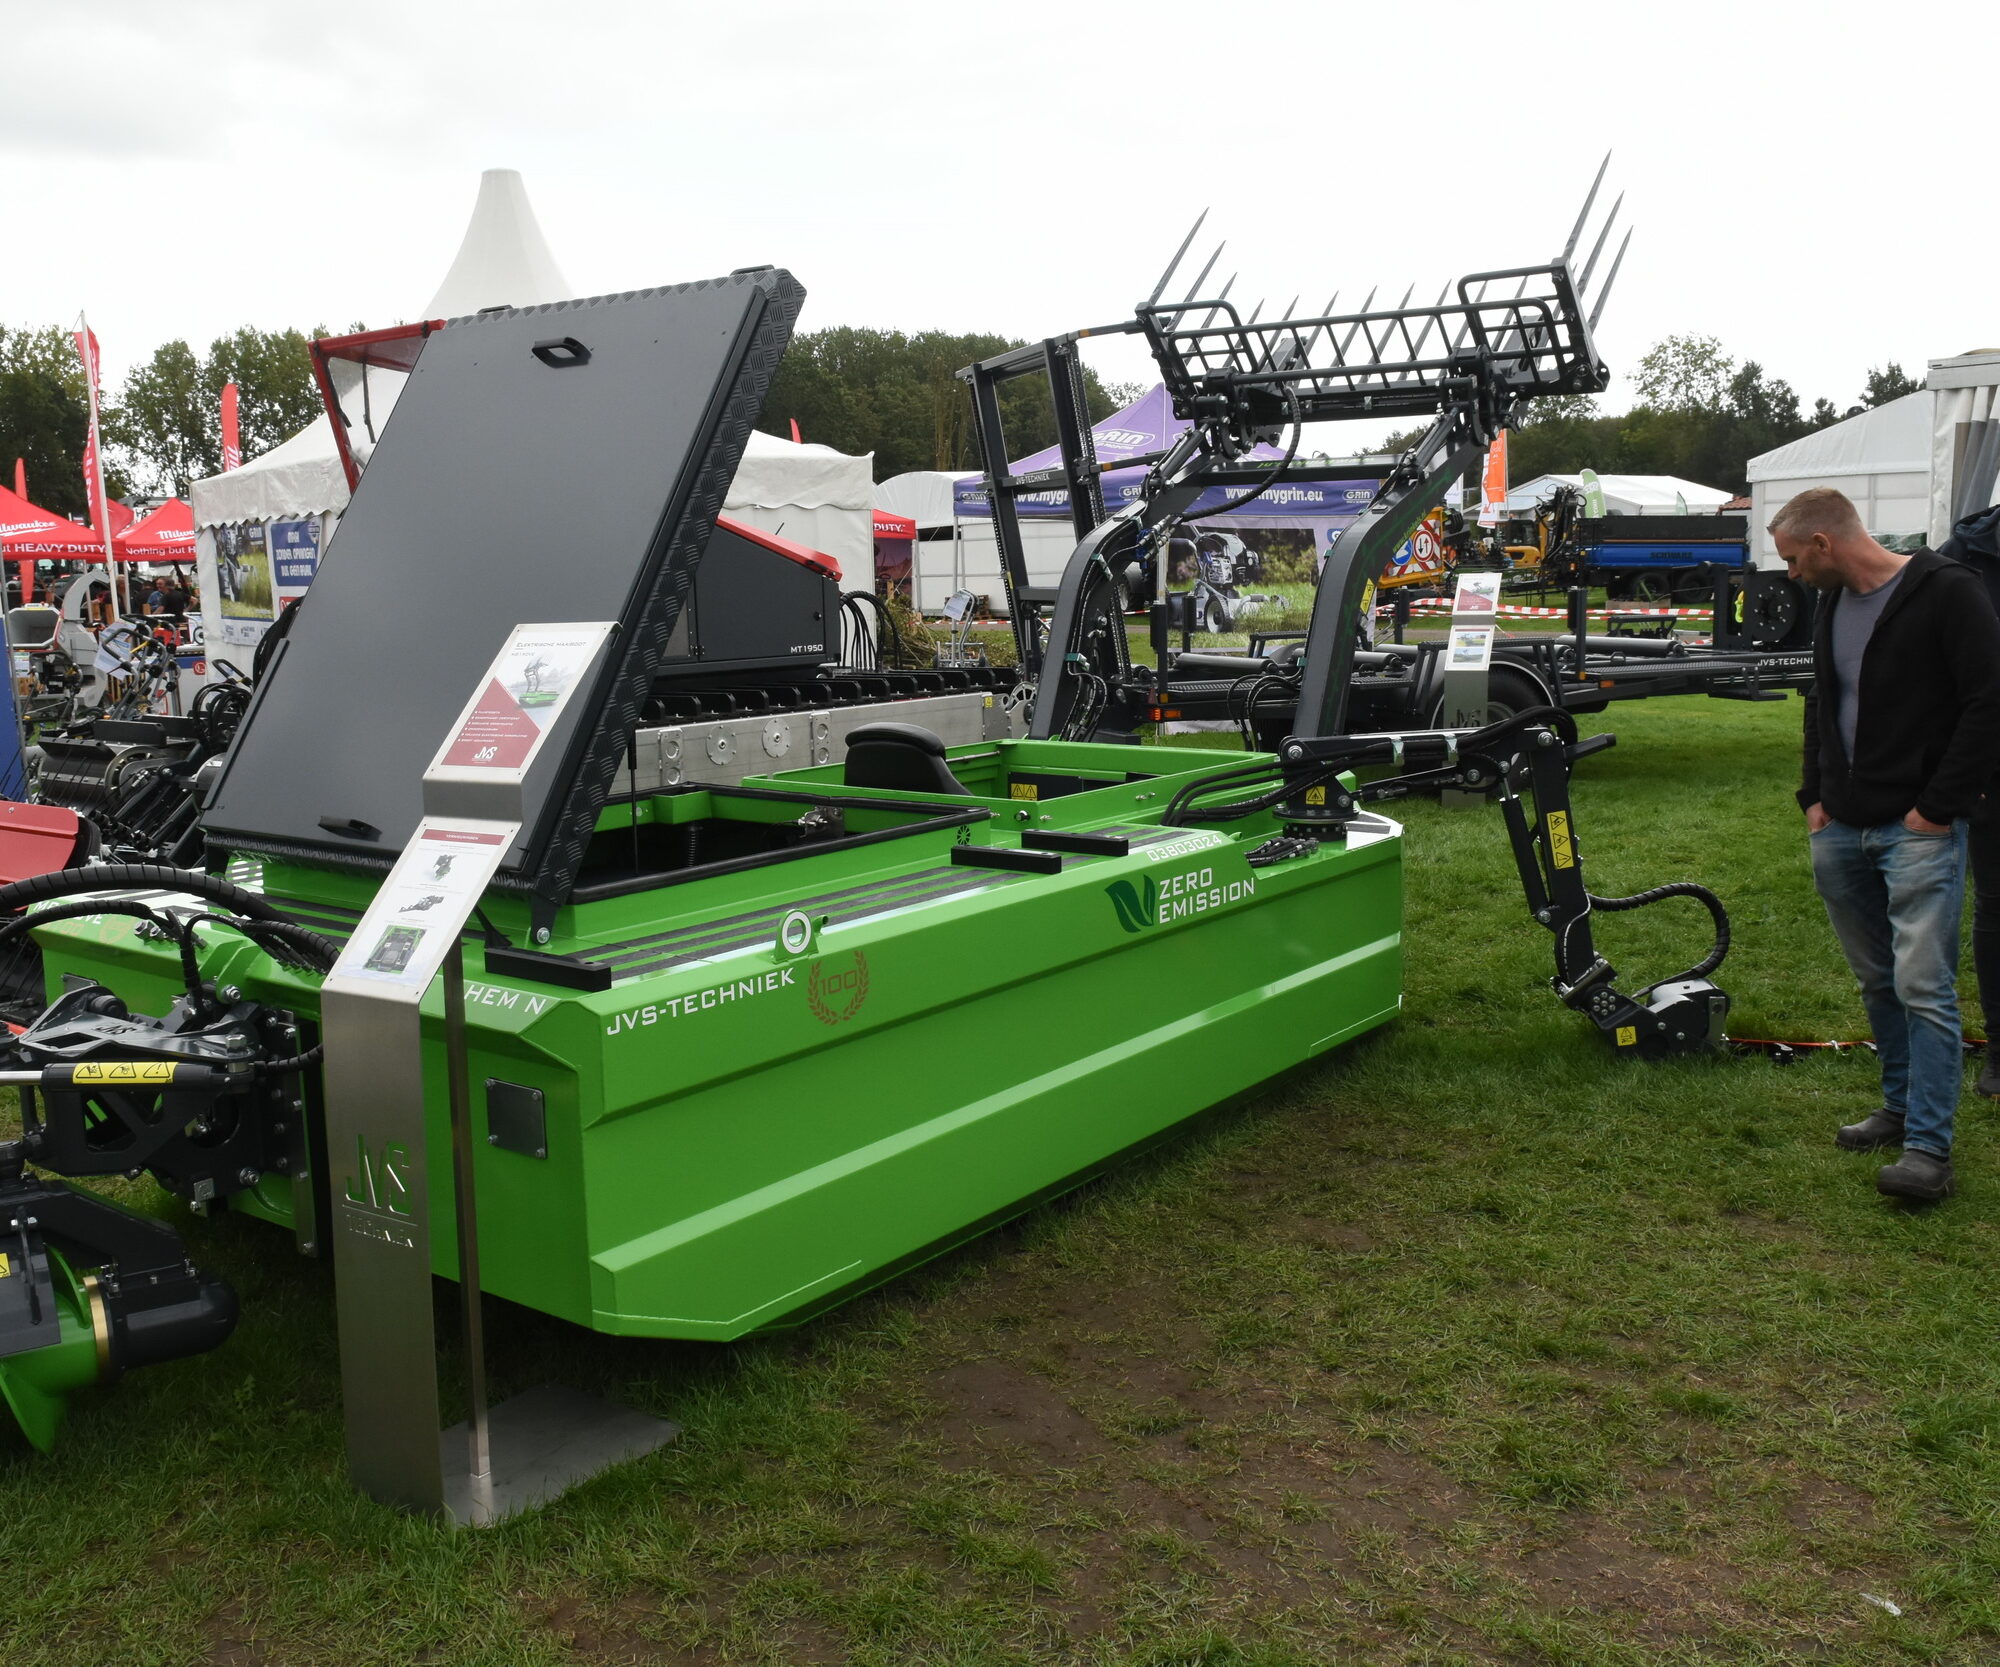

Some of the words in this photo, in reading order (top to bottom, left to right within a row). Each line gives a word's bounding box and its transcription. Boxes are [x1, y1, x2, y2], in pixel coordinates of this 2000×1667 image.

[0, 520, 56, 531] lwaukee
[156, 530, 194, 539] Milwa
[15, 543, 64, 553] HEAVY
[126, 547, 166, 556] Nothing
[169, 546, 185, 554] but
[1757, 656, 1814, 667] JVS-TECHNI
[474, 746, 498, 759] JVS
[1146, 834, 1222, 862] 03803024
[1159, 867, 1213, 901] ZERO
[1158, 877, 1255, 924] EMISSION
[821, 969, 858, 997] 100
[606, 967, 796, 1036] JVS-TECHNIEK
